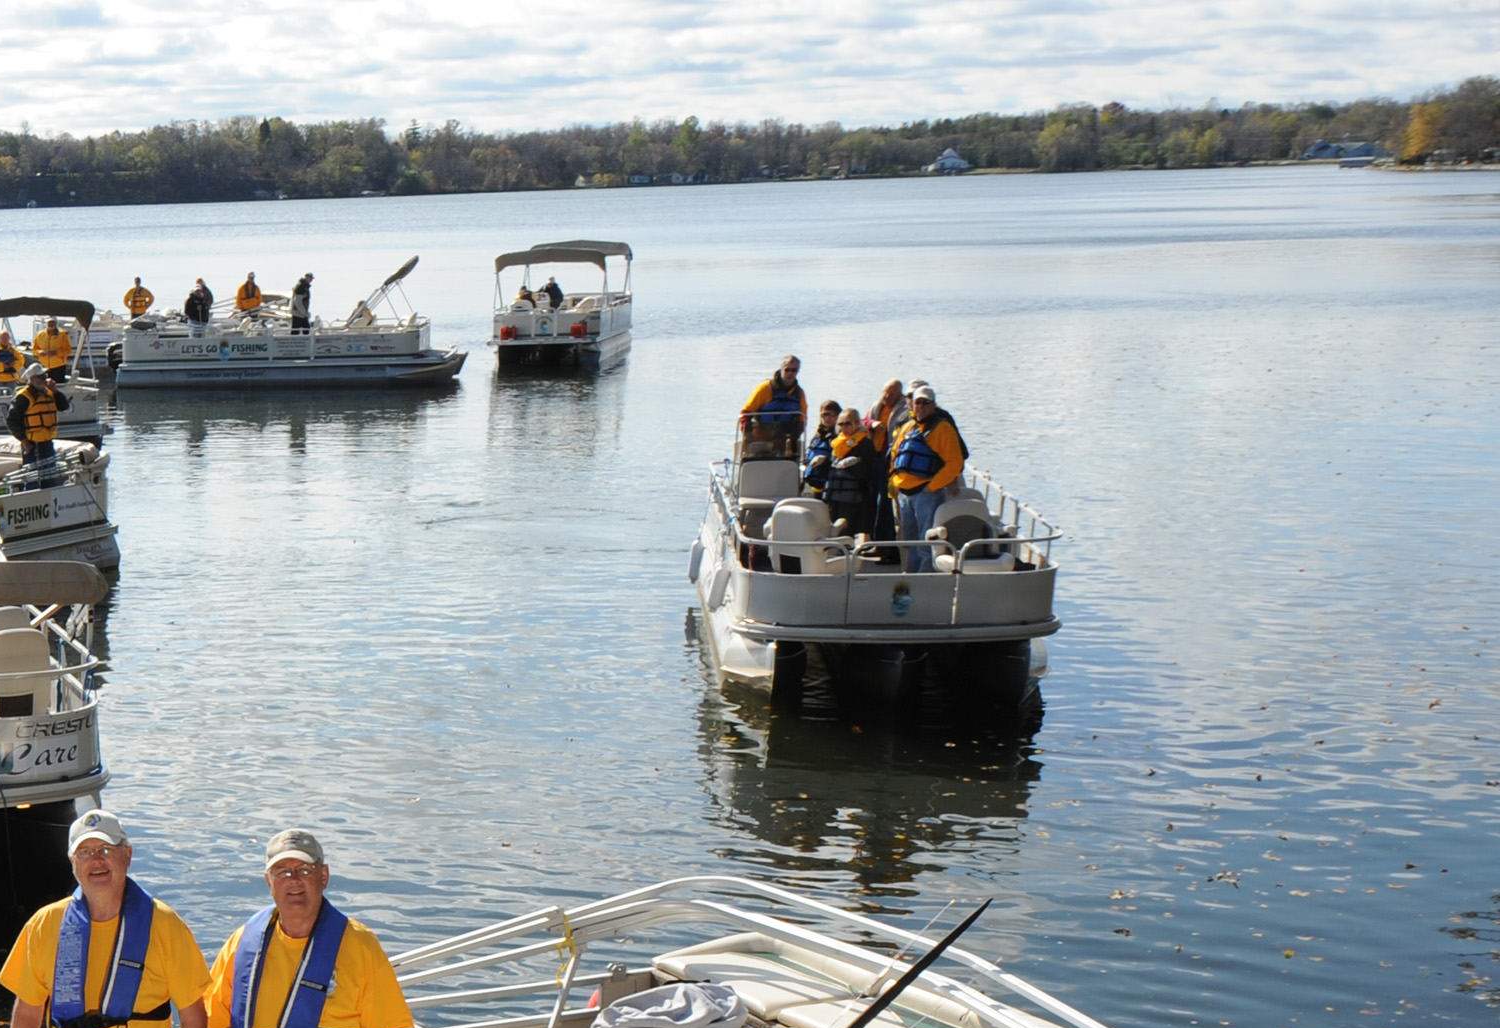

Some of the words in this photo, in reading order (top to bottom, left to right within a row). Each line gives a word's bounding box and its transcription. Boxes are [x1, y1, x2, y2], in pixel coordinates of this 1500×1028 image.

[181, 345, 204, 354] LET'S
[206, 344, 218, 353] GO
[231, 343, 268, 353] FISHING
[7, 503, 50, 525] FISHING
